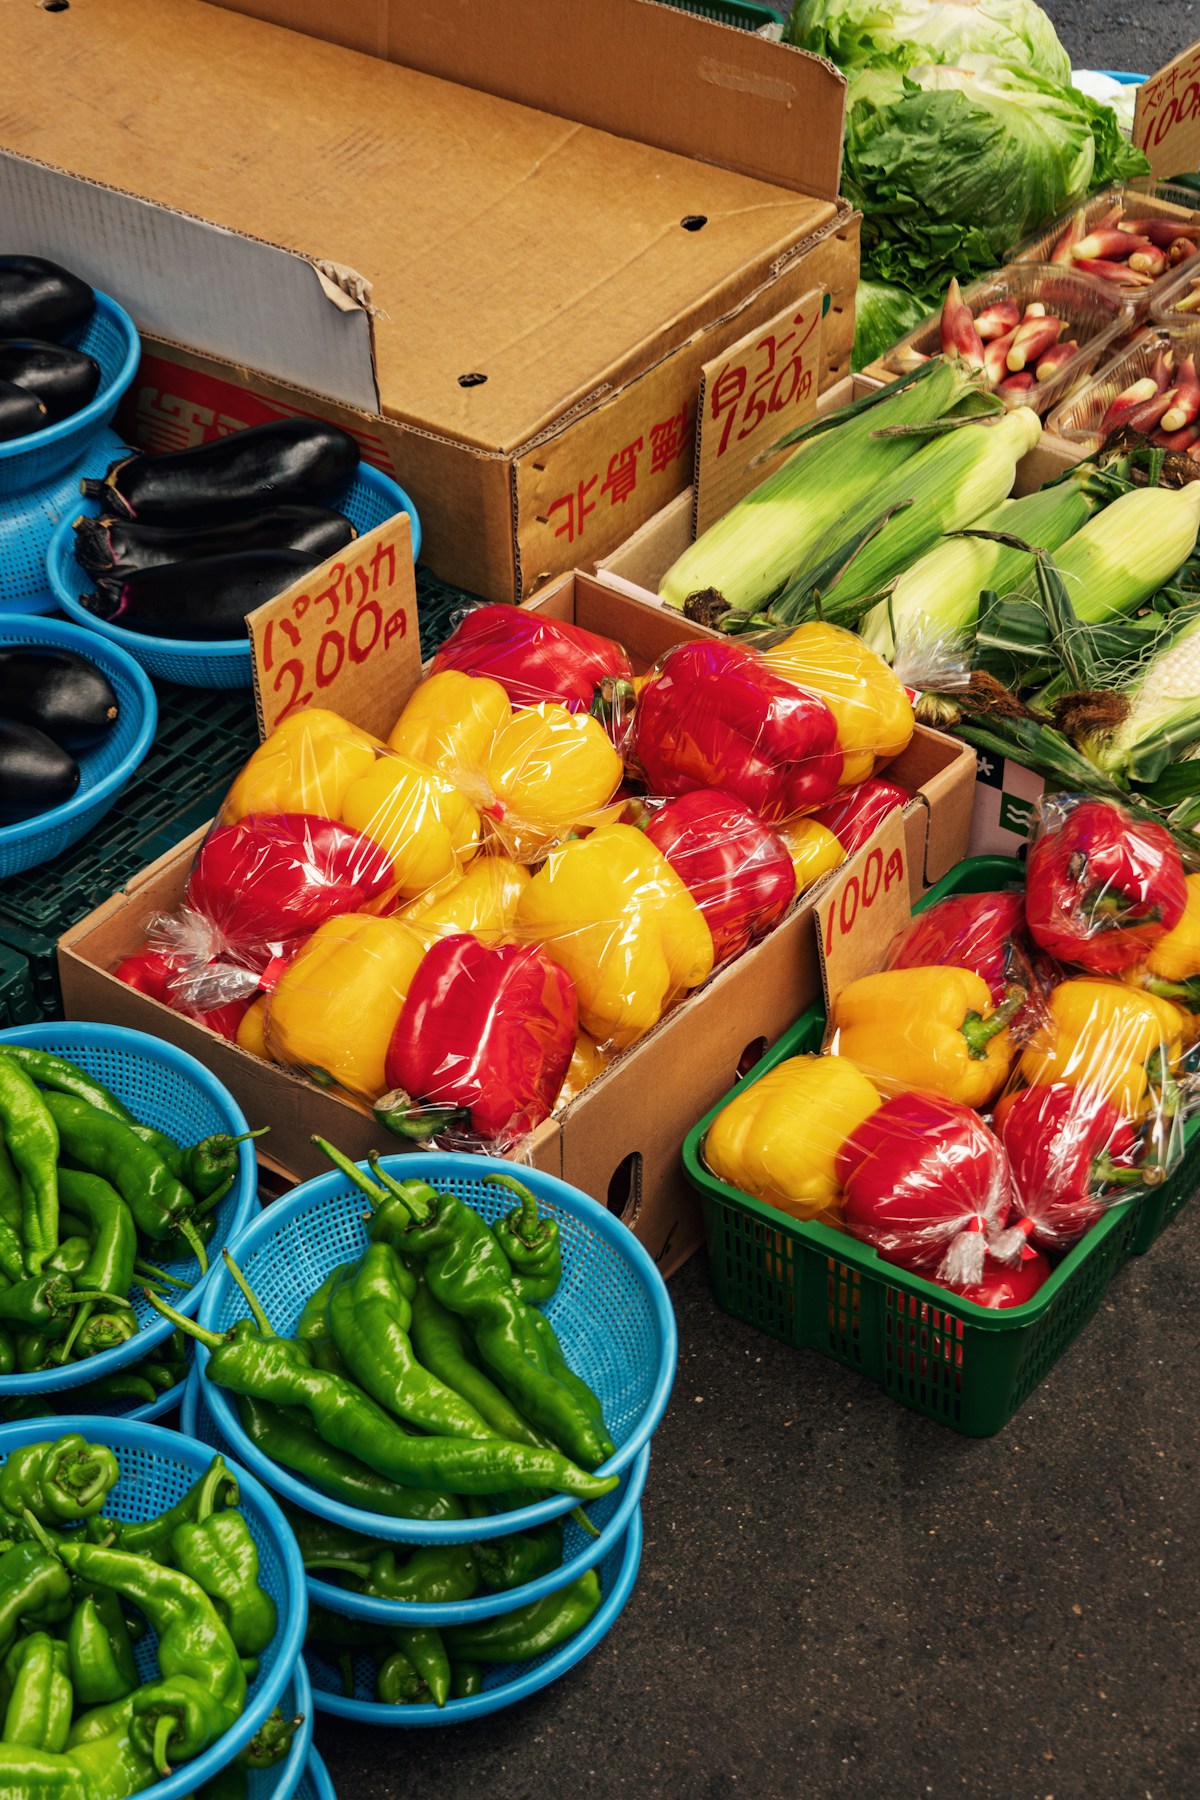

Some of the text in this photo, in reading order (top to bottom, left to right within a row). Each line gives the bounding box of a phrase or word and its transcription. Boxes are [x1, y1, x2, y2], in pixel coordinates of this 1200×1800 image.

[711, 311, 820, 421] 白コーン
[716, 355, 812, 458] 150円
[263, 542, 396, 672] パプリカ
[273, 600, 406, 727] 200円
[825, 847, 904, 957] 100円
